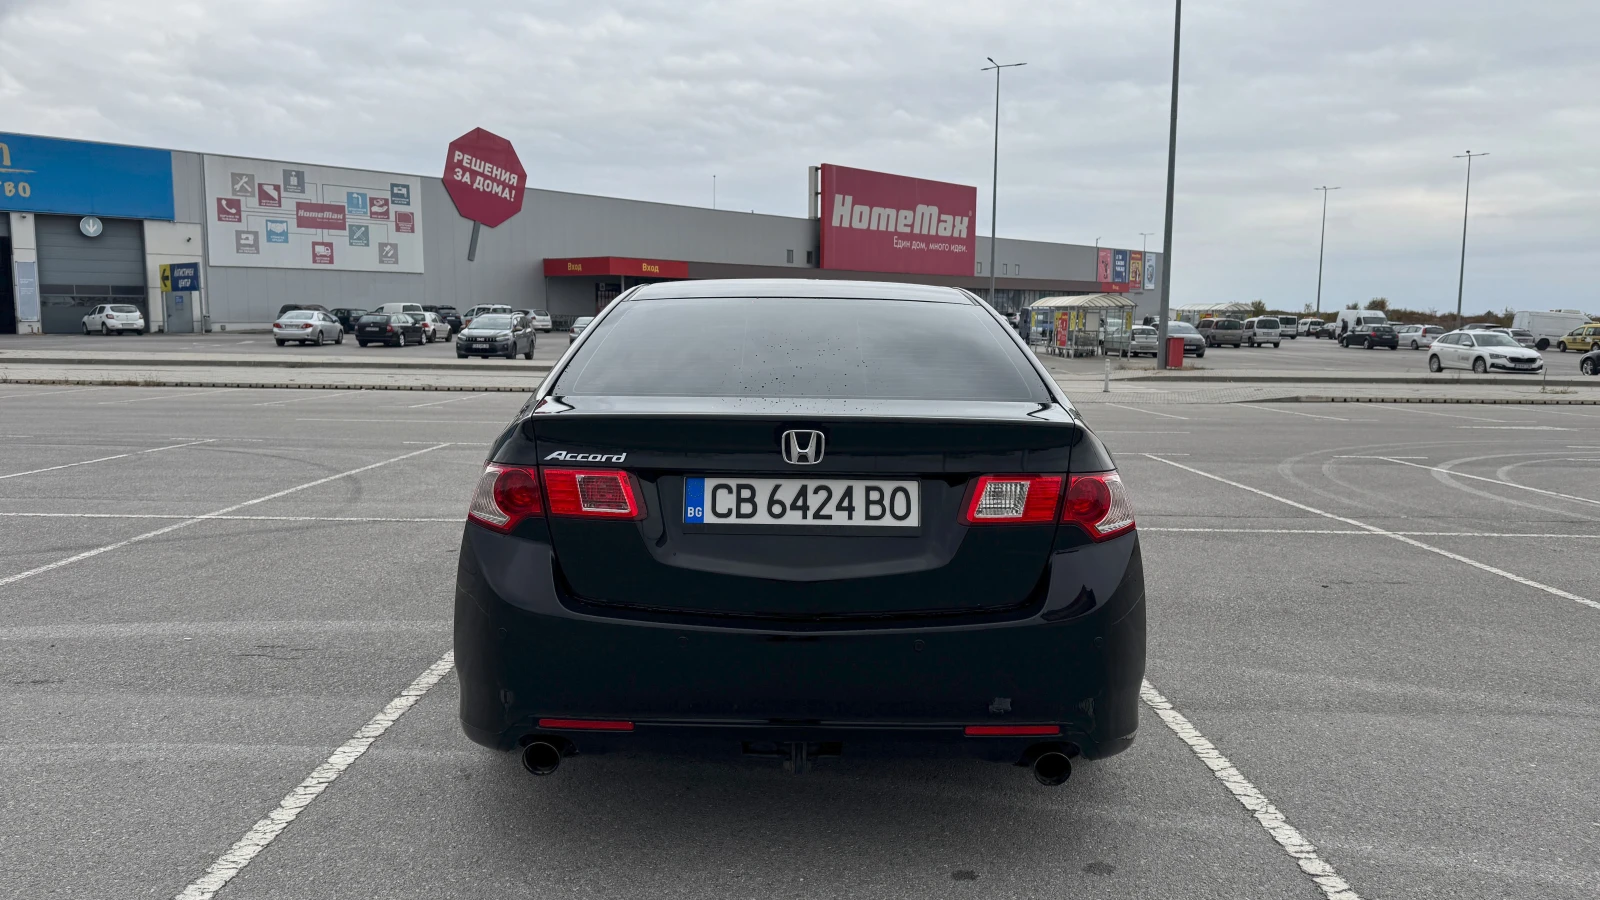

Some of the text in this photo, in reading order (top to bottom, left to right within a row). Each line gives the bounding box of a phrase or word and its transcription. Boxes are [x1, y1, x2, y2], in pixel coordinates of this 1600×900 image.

[453, 150, 519, 187] РЕШЕНИЯ
[0, 181, 31, 198] ВО
[453, 168, 516, 202] ЗА ДОМА!
[831, 193, 969, 239] HomeMax
[893, 235, 968, 253] Един дом, много идеи.
[567, 262, 583, 272] Вход
[642, 263, 660, 273] Вход
[544, 450, 627, 463] Accord
[711, 483, 758, 519] CB
[766, 484, 856, 521] 6424
[687, 507, 702, 517] BG
